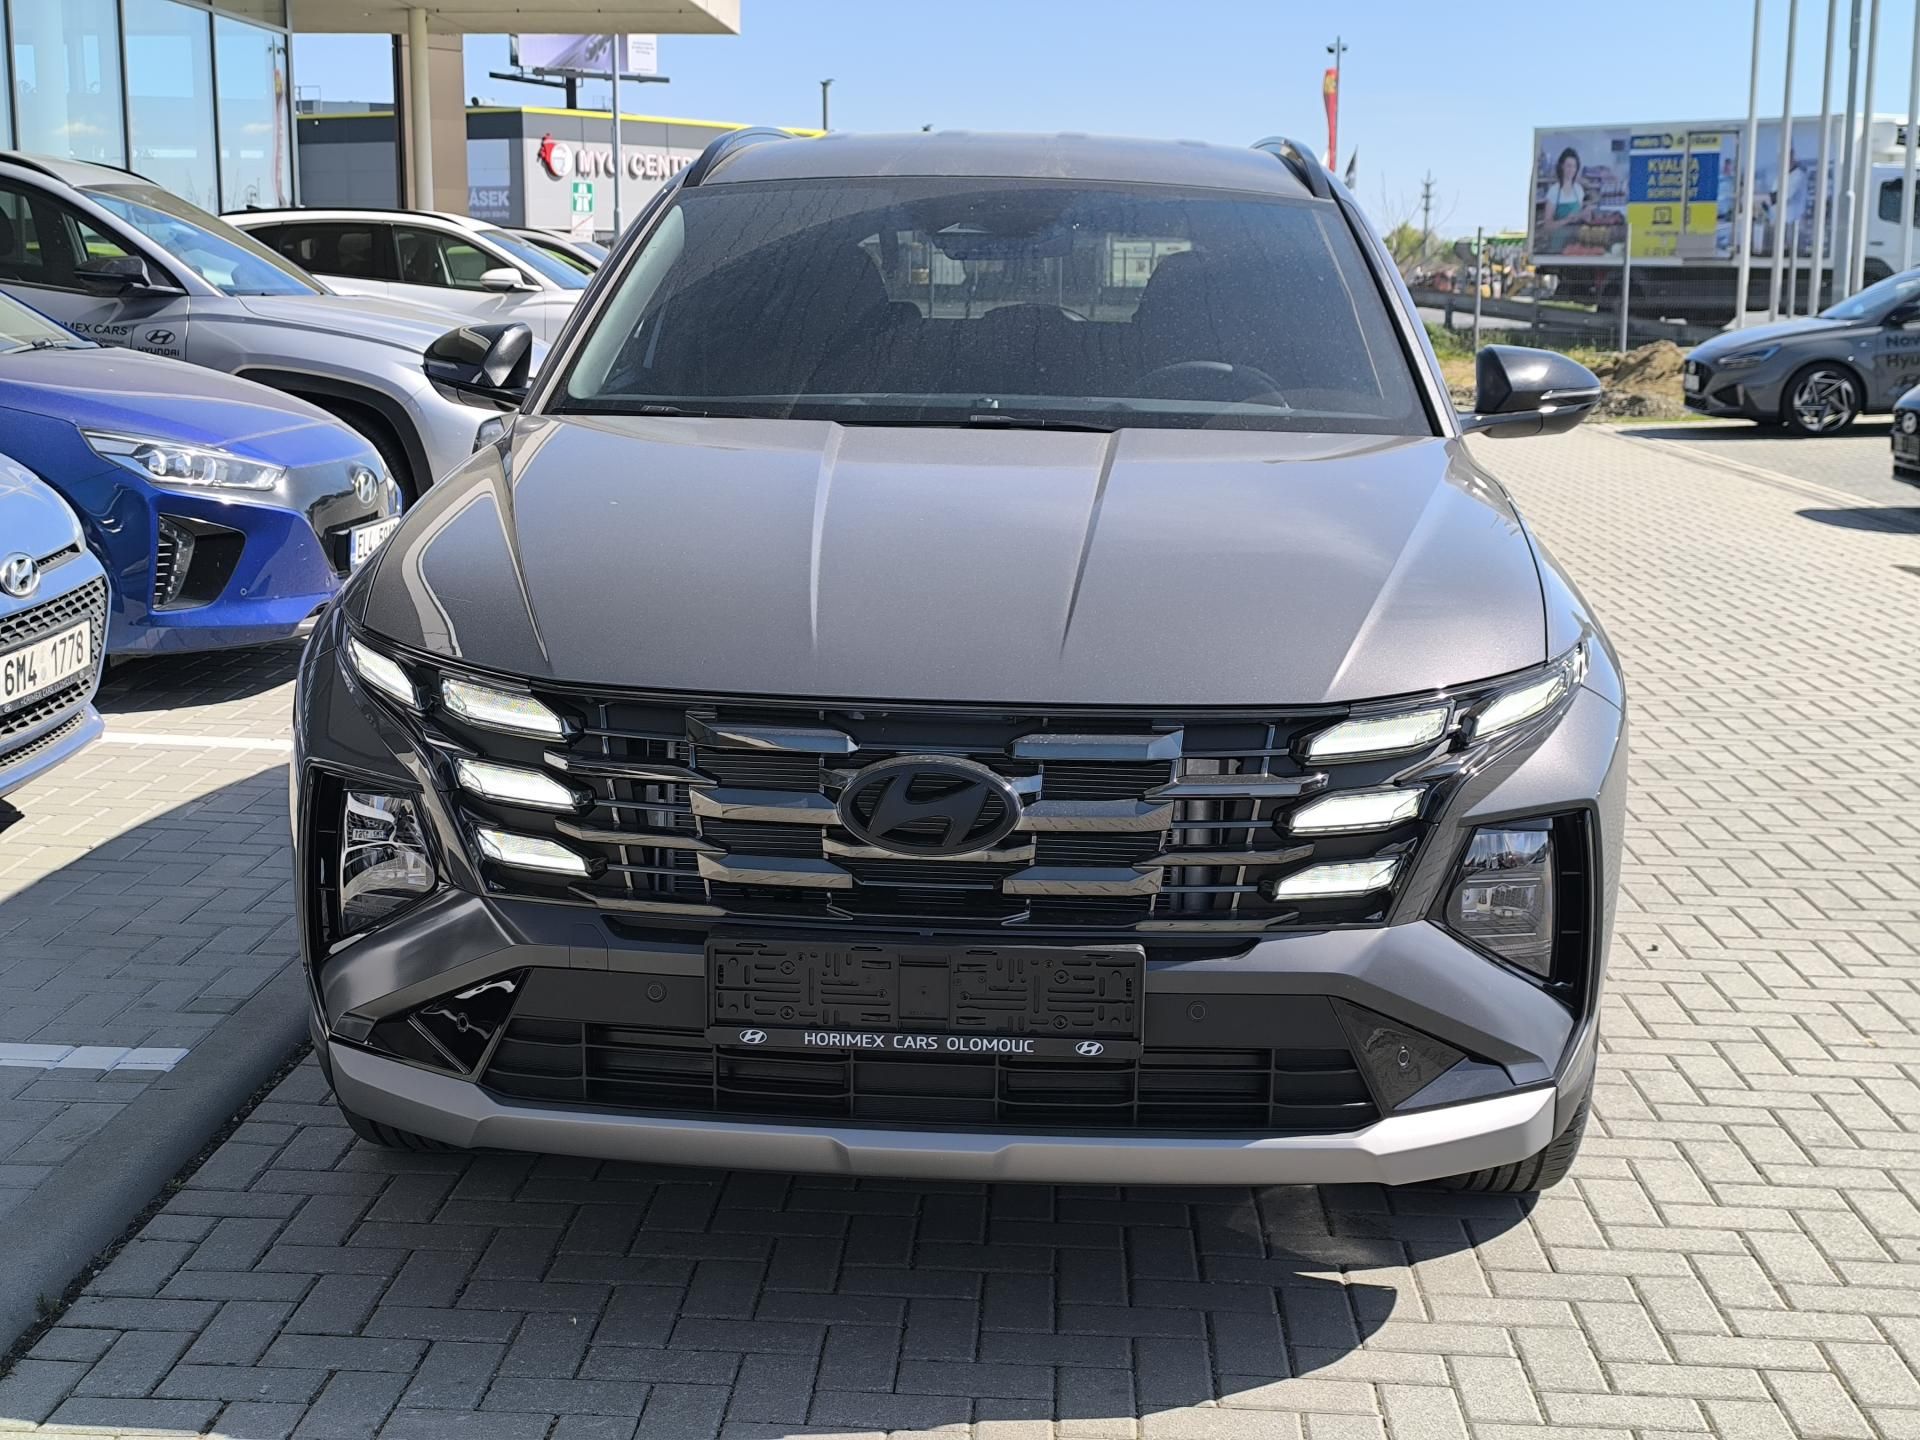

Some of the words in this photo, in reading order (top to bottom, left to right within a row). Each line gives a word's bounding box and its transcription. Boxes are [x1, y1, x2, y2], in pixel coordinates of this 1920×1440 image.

[94, 323, 128, 336] CARS
[4, 650, 37, 697] 6M4
[50, 629, 84, 677] 1778
[804, 1031, 885, 1048] HORIMEX
[893, 1035, 938, 1050] CARS
[946, 1037, 1034, 1053] OLOMOUC
